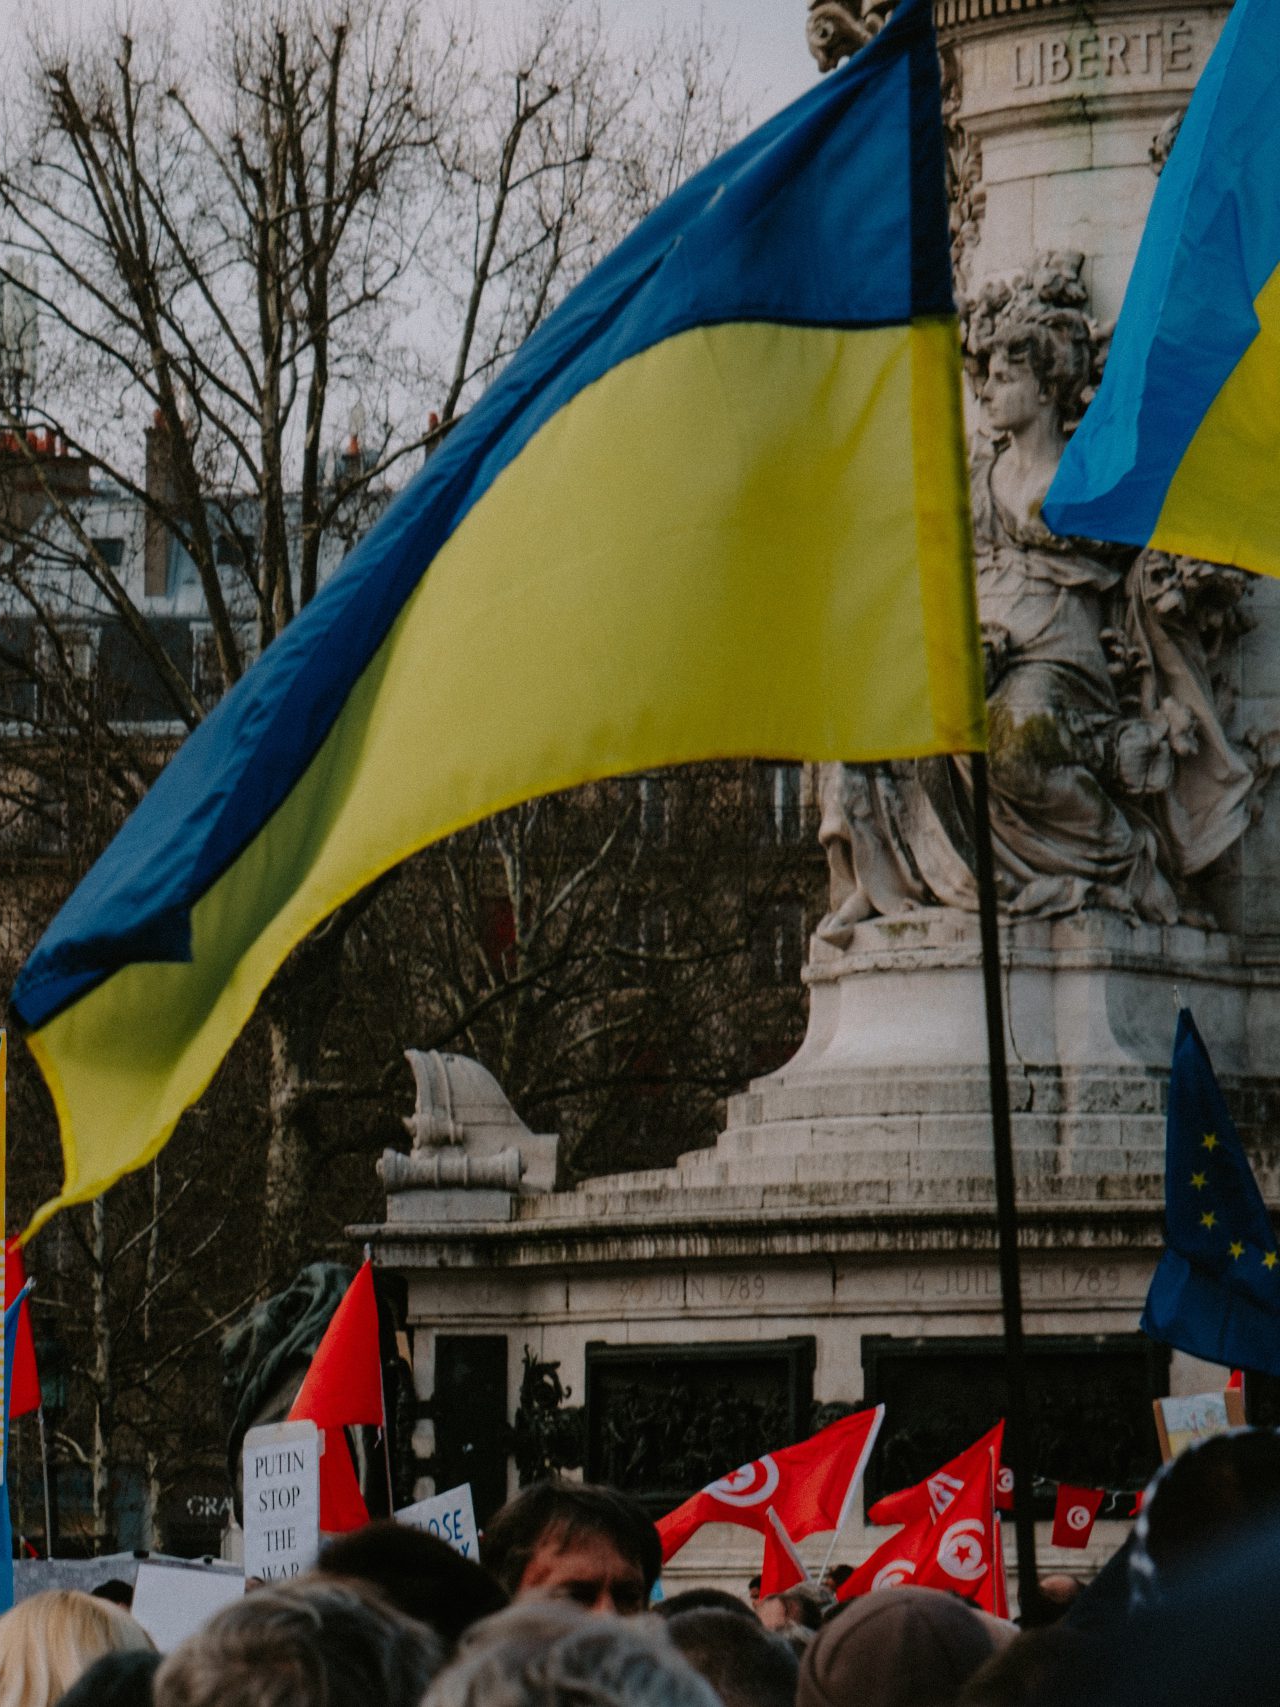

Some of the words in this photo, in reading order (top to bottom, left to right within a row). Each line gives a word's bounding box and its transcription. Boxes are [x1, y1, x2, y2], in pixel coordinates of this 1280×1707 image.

[1013, 21, 1193, 91] LIBERTÉ
[718, 1274, 766, 1301] 1789
[255, 1448, 305, 1479] PUTIN
[259, 1485, 300, 1512] STOP
[263, 1527, 297, 1553] THE
